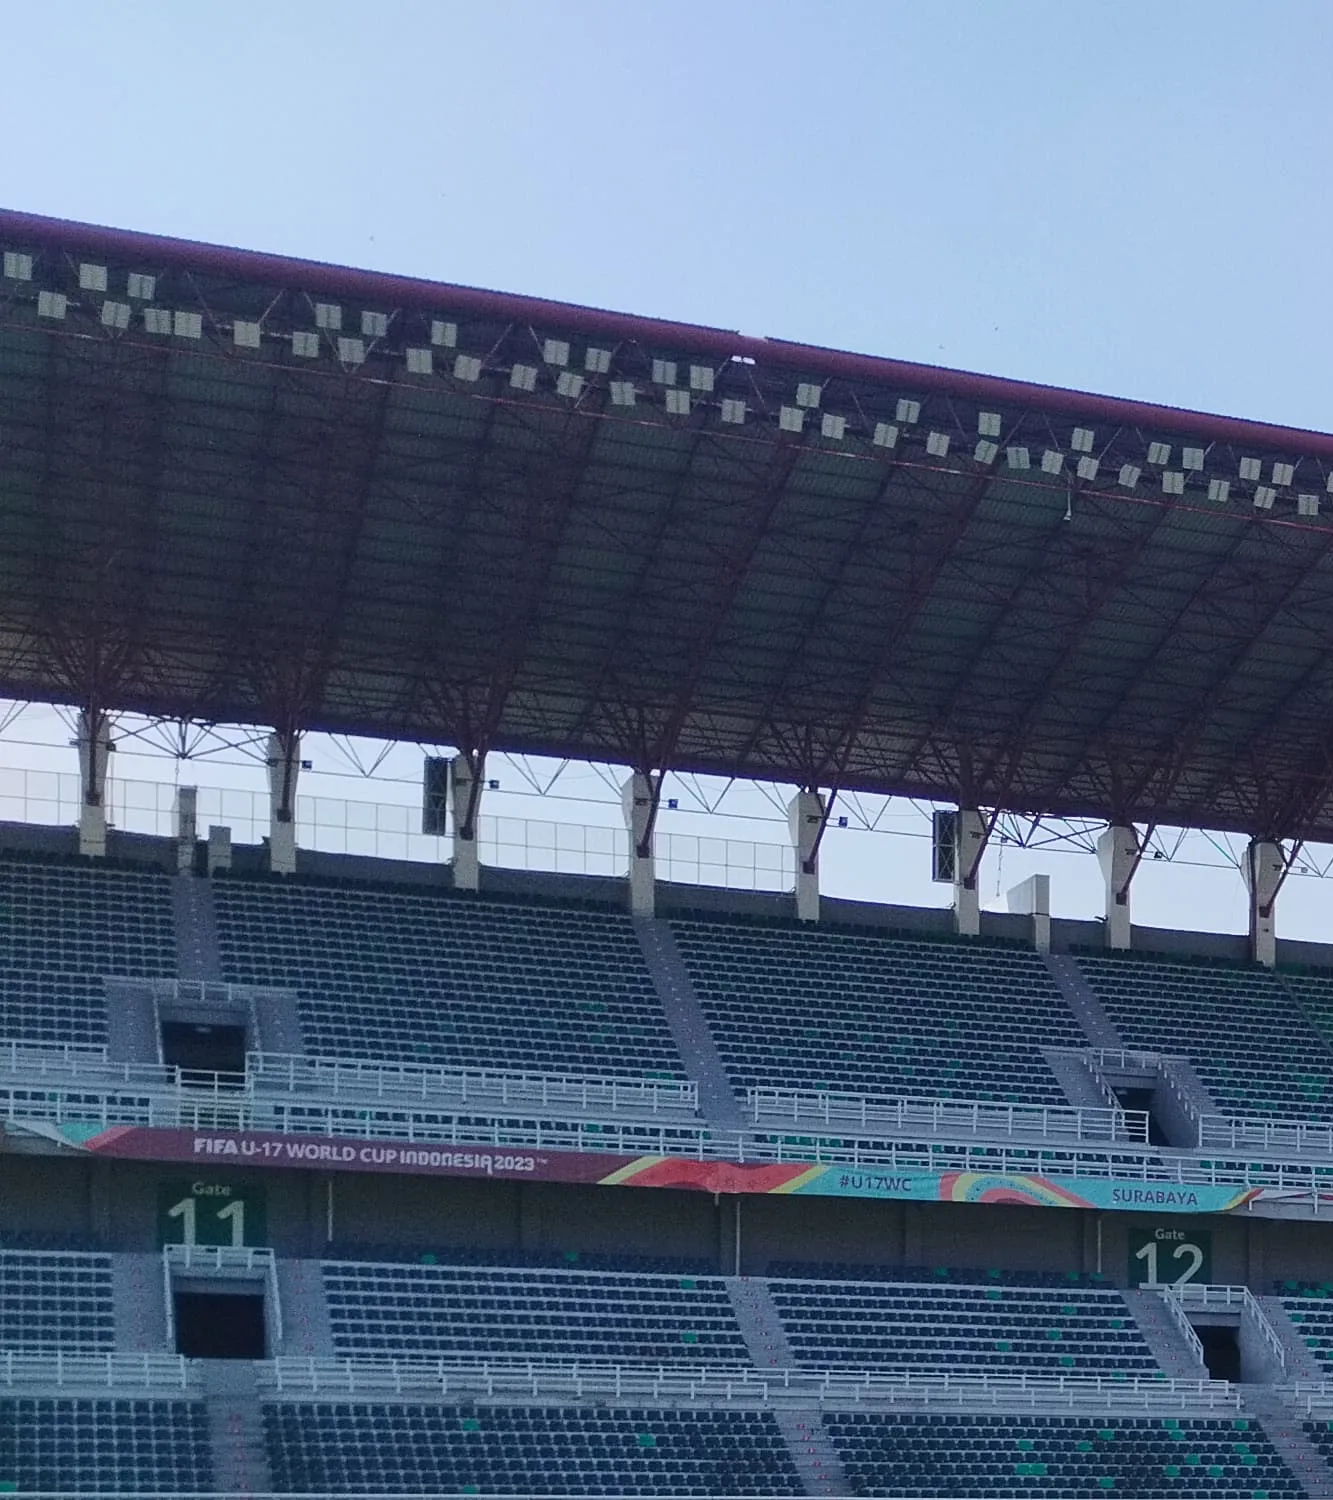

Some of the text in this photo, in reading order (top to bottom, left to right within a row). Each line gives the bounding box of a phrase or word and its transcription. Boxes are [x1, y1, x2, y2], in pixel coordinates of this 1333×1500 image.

[193, 1138, 239, 1154] FIFA
[241, 1140, 283, 1157] U-17
[286, 1143, 355, 1161] WORLD
[359, 1147, 397, 1163] CUP
[400, 1150, 493, 1175] INDONESIA
[192, 1181, 232, 1196] Gate
[840, 1174, 912, 1191] #U17WC
[1112, 1189, 1198, 1205] SURABAYA
[168, 1198, 244, 1249] 11
[1154, 1228, 1185, 1240] Gate
[1136, 1242, 1203, 1289] 12
